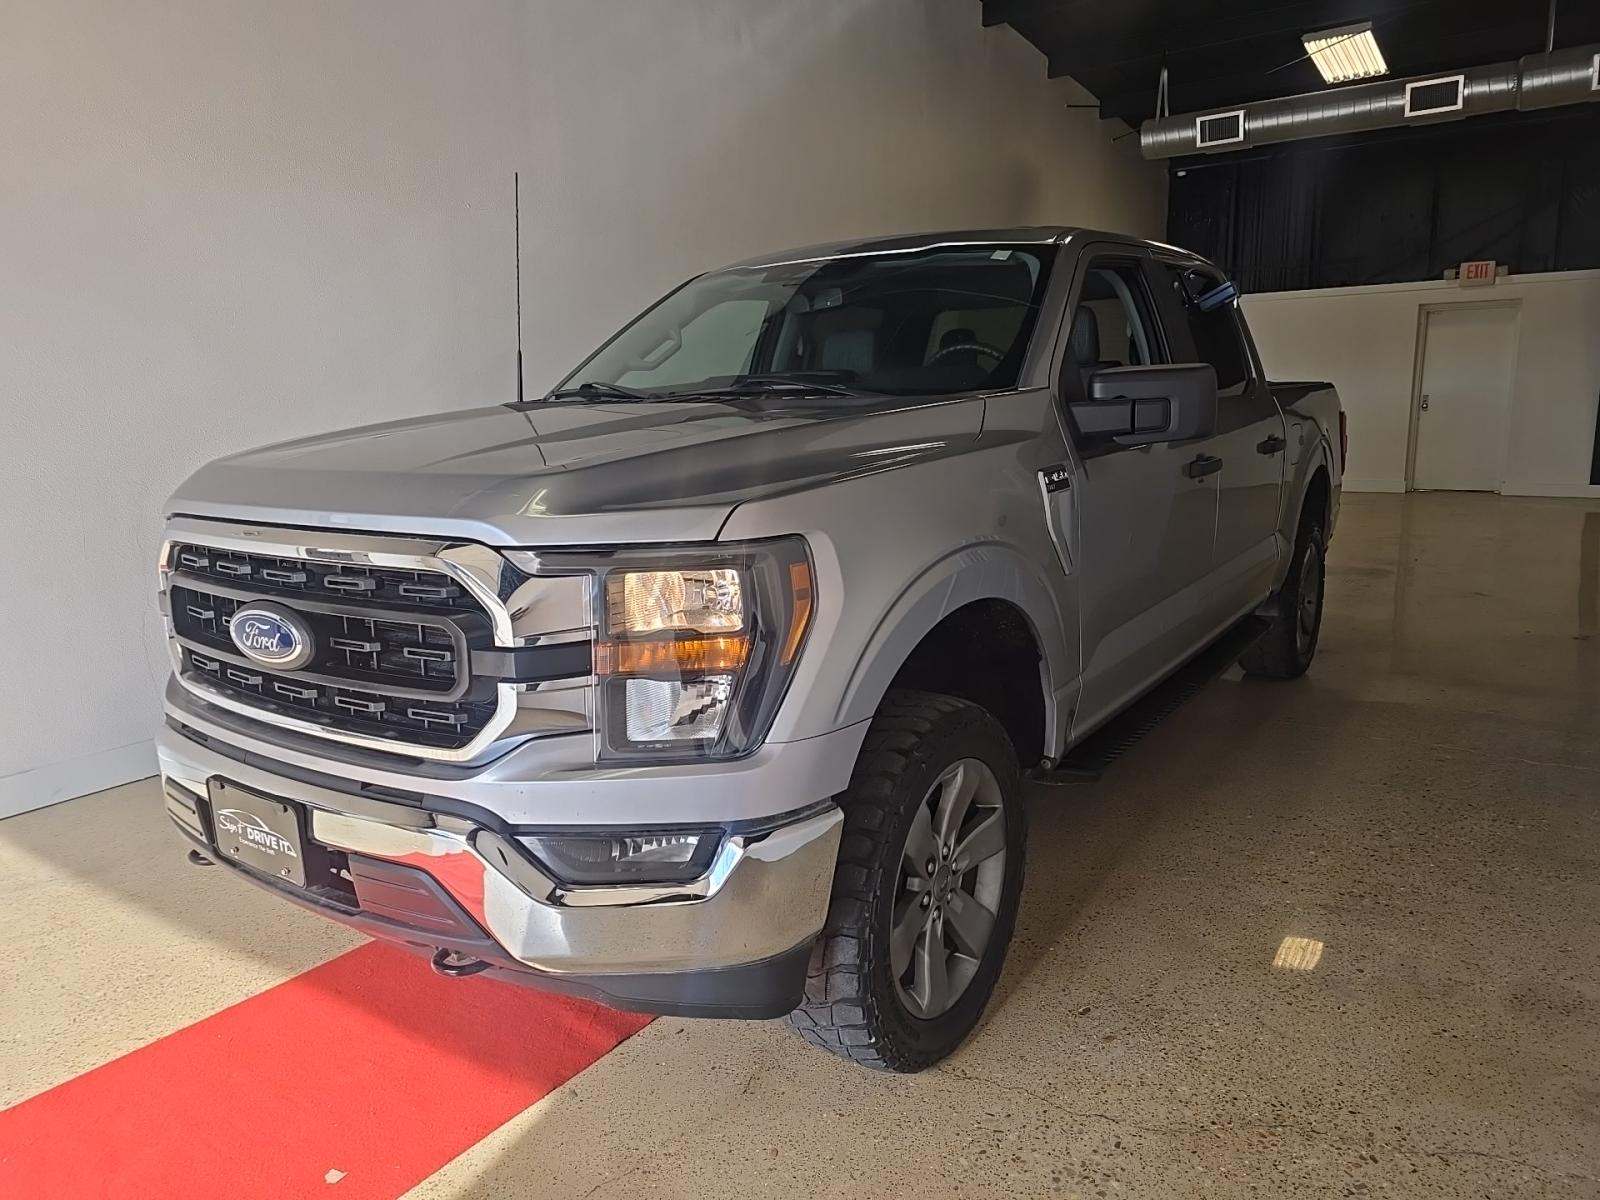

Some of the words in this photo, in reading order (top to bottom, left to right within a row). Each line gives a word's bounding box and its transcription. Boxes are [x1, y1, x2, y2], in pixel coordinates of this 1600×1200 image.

[1467, 264, 1488, 279] EXIT
[243, 620, 281, 652] Ford
[246, 826, 279, 849] DRIVE
